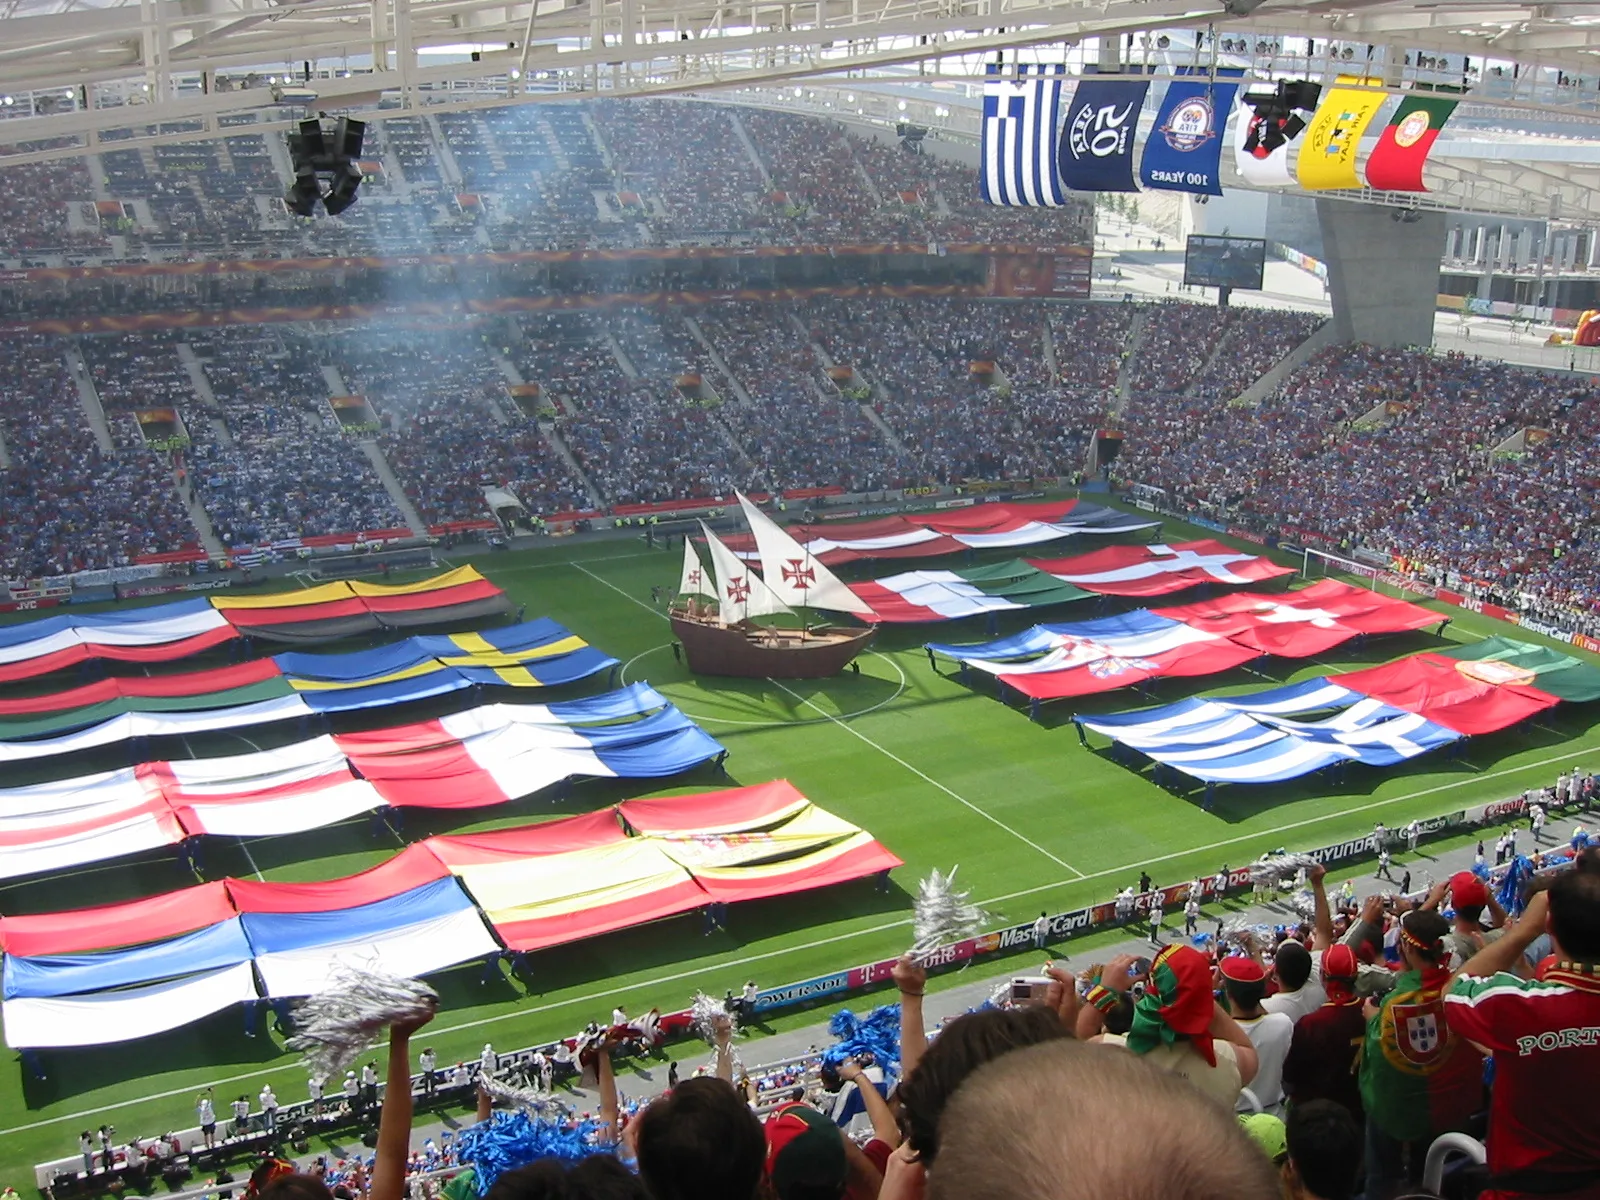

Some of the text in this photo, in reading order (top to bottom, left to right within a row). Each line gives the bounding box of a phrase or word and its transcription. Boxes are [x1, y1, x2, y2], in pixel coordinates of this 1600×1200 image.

[16, 600, 37, 611] JVC
[1458, 596, 1483, 613] JVC
[1518, 615, 1574, 644] MasterCard
[1484, 798, 1527, 818] Canon
[1313, 836, 1378, 863] HYUNDA
[999, 908, 1089, 949] MastrCard
[756, 978, 847, 1006] OWERADE
[1516, 1026, 1600, 1056] PORT
